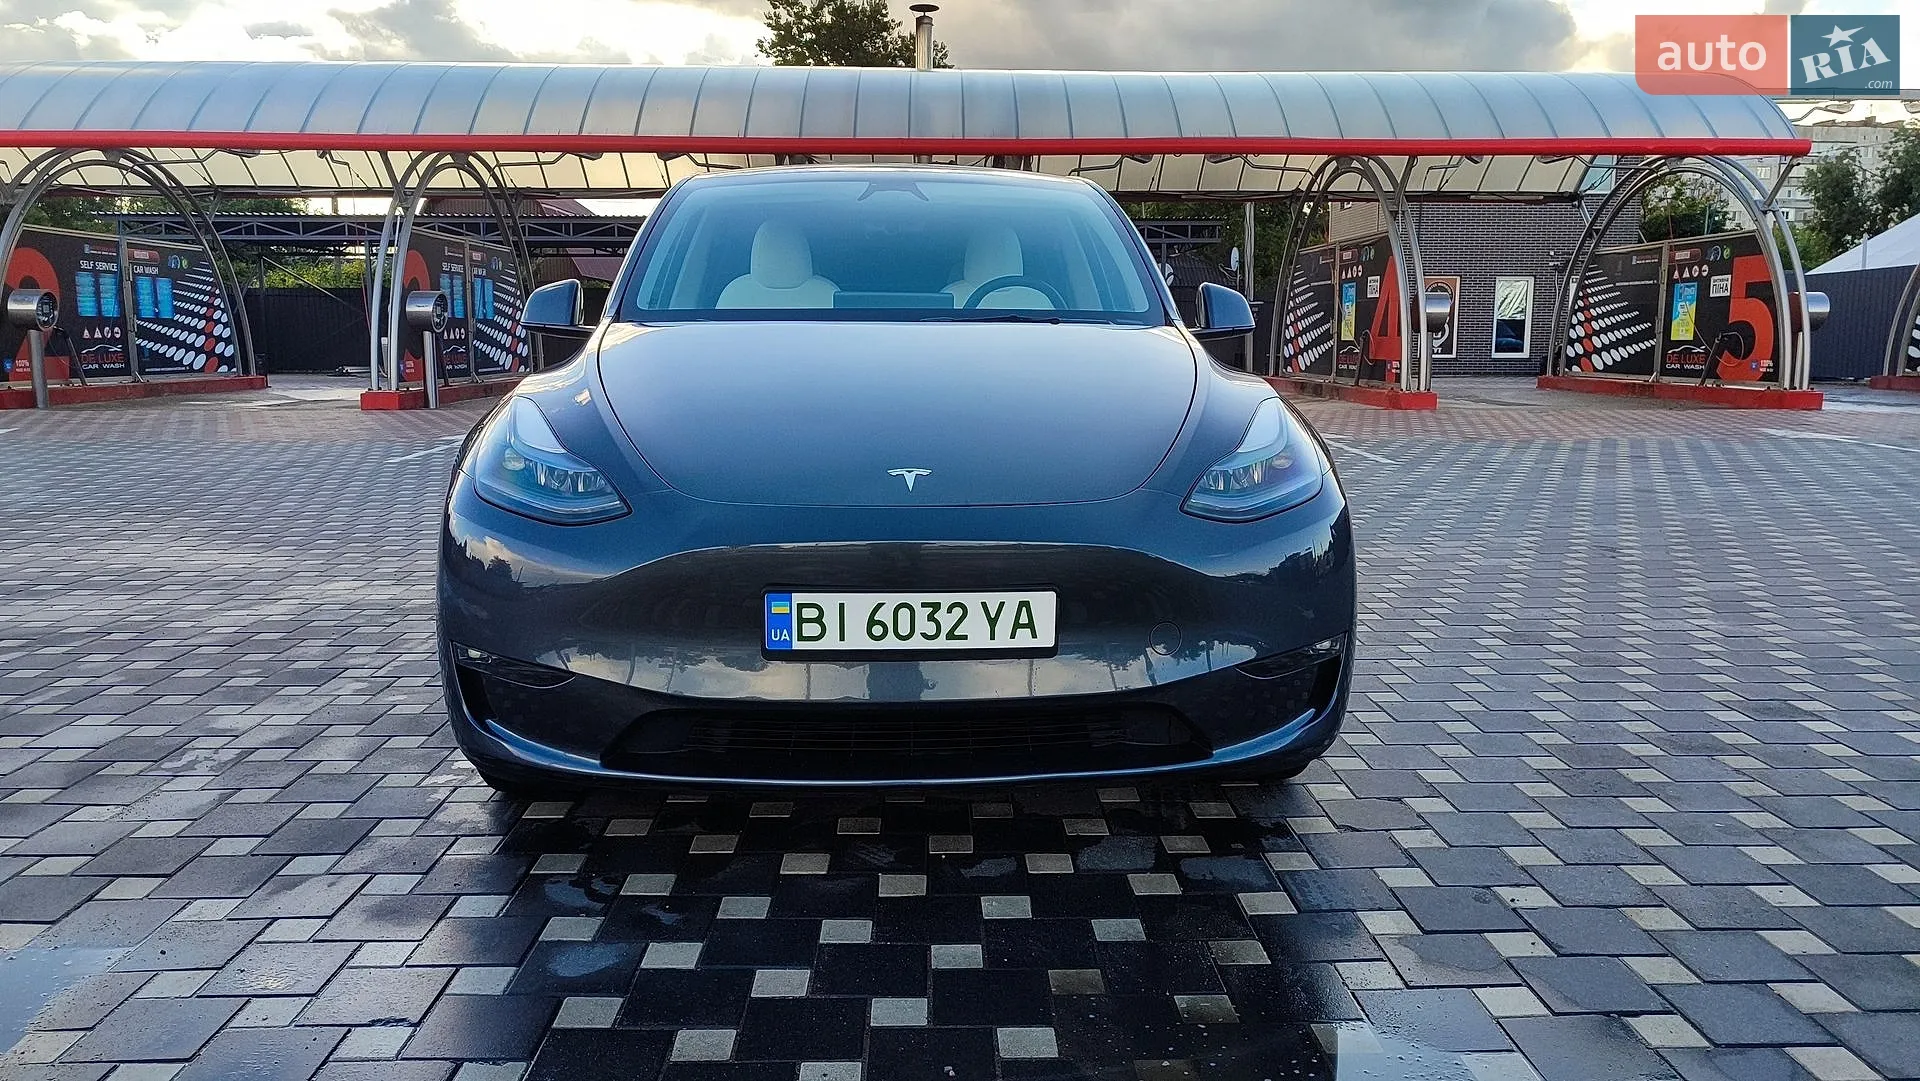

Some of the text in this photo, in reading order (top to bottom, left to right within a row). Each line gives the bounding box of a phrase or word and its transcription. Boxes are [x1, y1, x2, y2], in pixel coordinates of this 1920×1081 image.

[80, 260, 118, 272] SELF SERVICE
[133, 265, 159, 275] CAR WASH
[1369, 255, 1402, 360] 4
[1716, 254, 1773, 382] 5
[80, 353, 125, 363] DE LUXE
[1666, 354, 1705, 364] DE LUXE
[796, 600, 1039, 642] BI 6032 YA
[771, 629, 791, 641] UA
